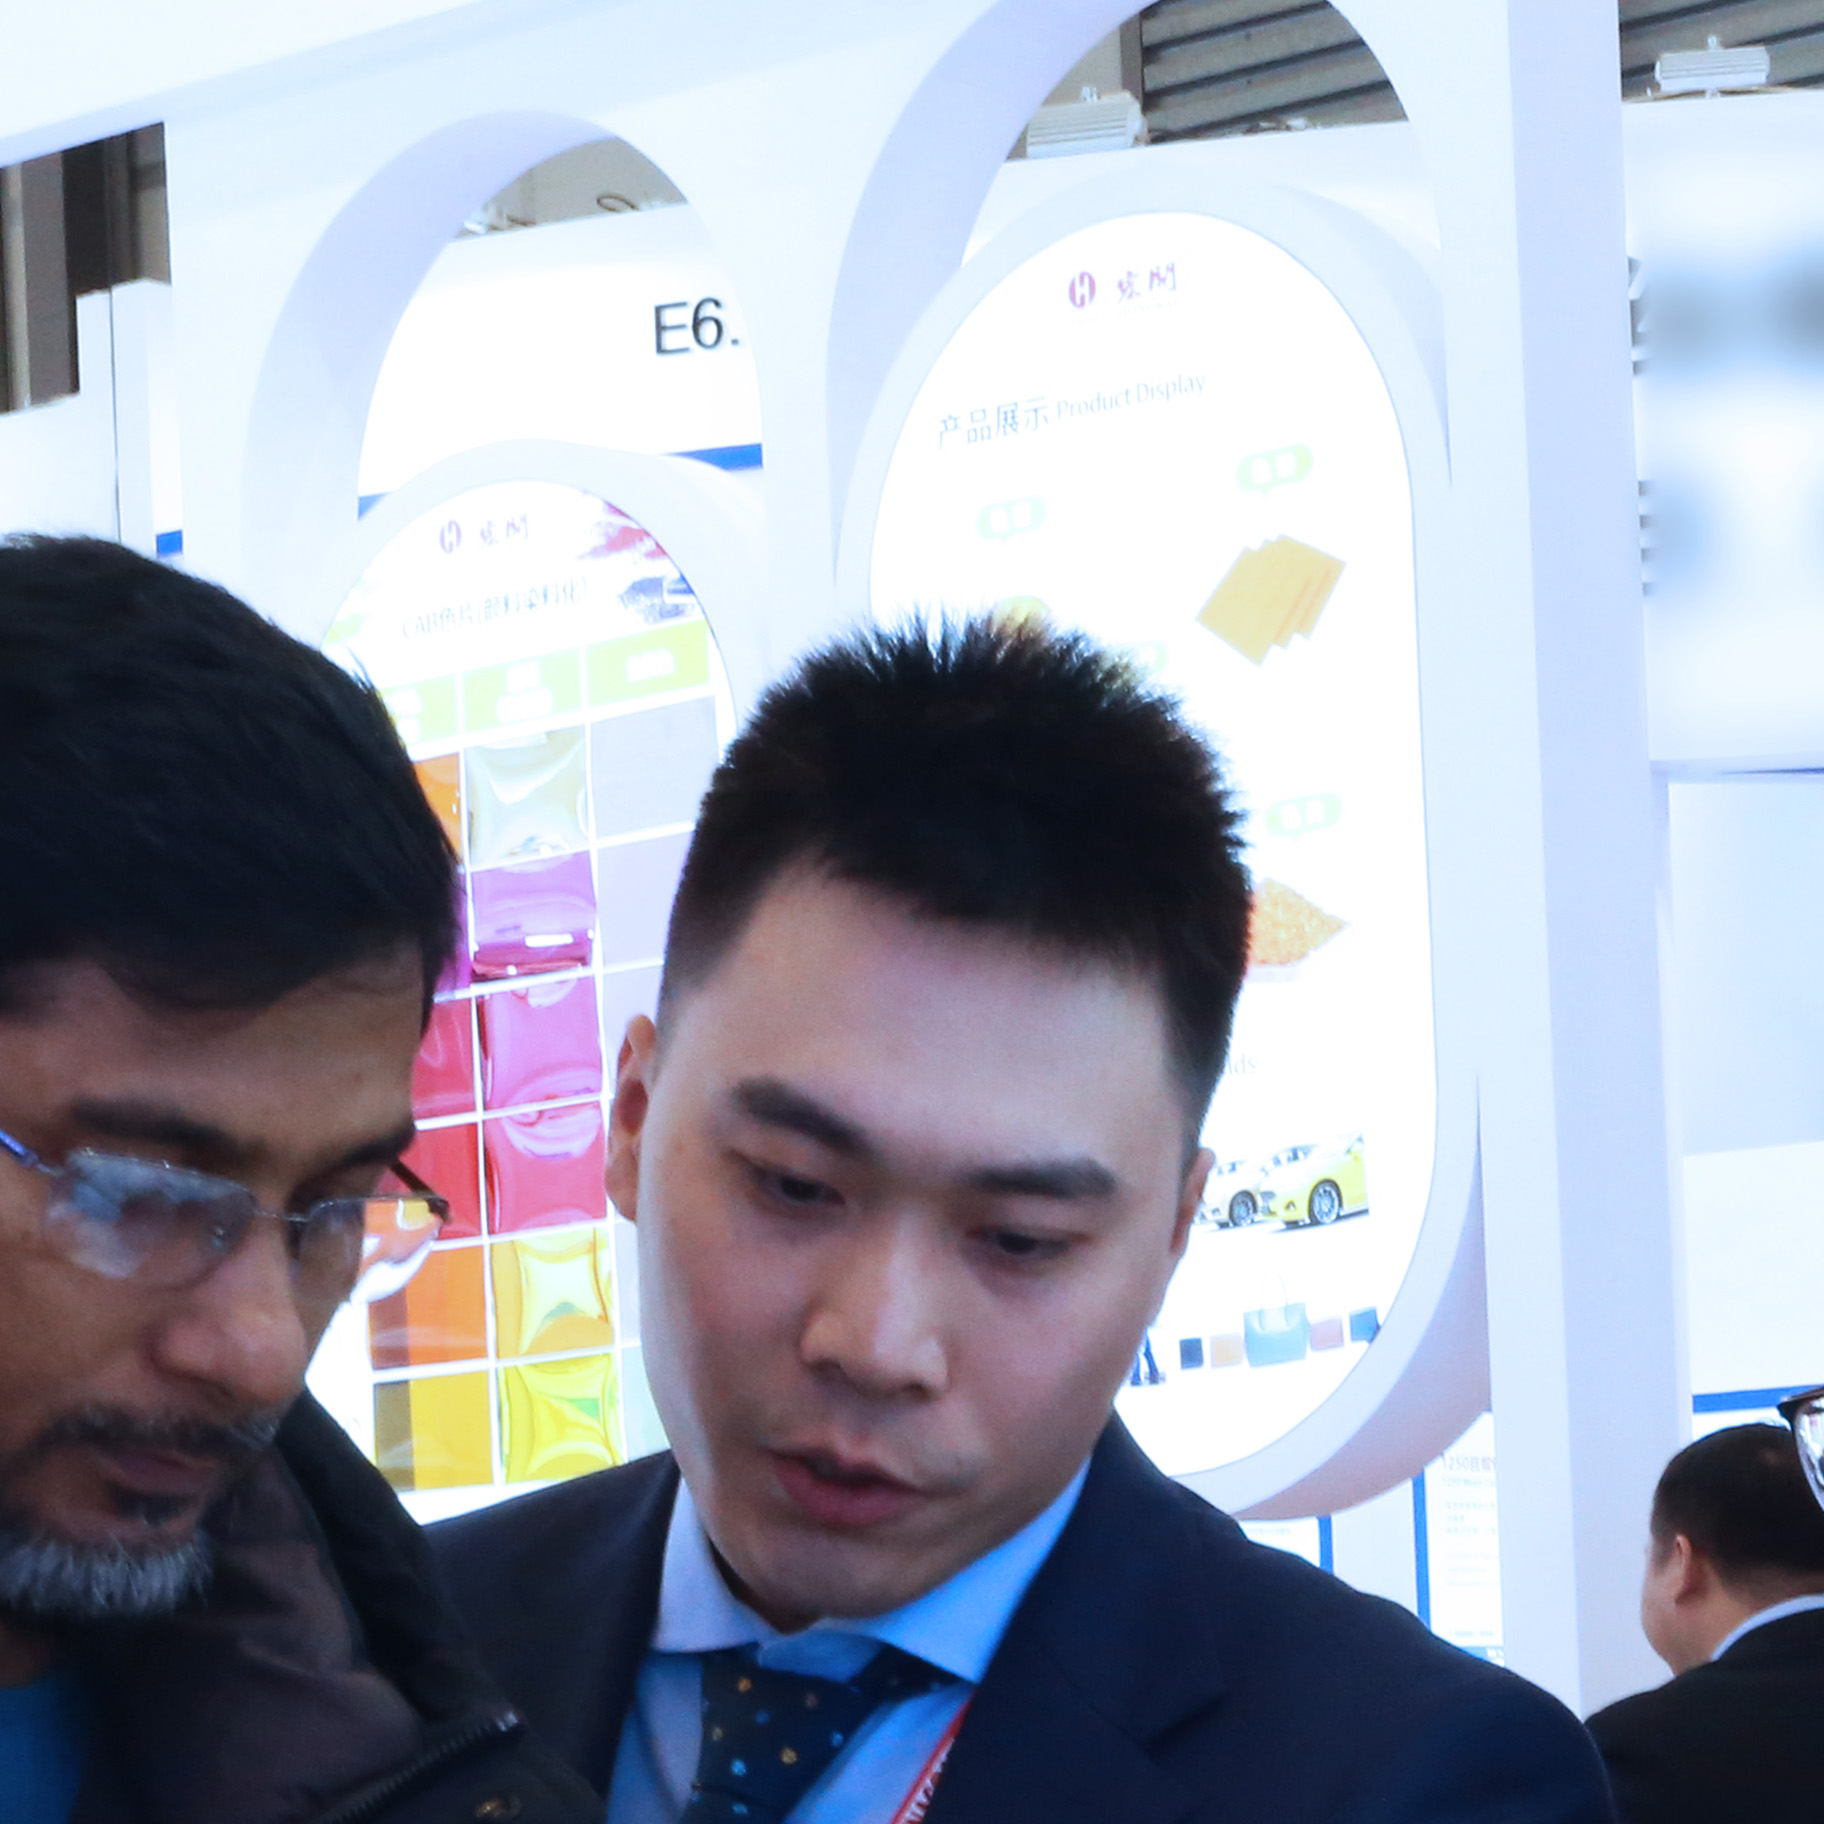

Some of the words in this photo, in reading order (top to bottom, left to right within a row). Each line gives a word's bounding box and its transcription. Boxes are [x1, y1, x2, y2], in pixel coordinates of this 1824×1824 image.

[938, 395, 1050, 450] 产品展示
[1056, 386, 1132, 422] Product
[1136, 372, 1207, 404] Display
